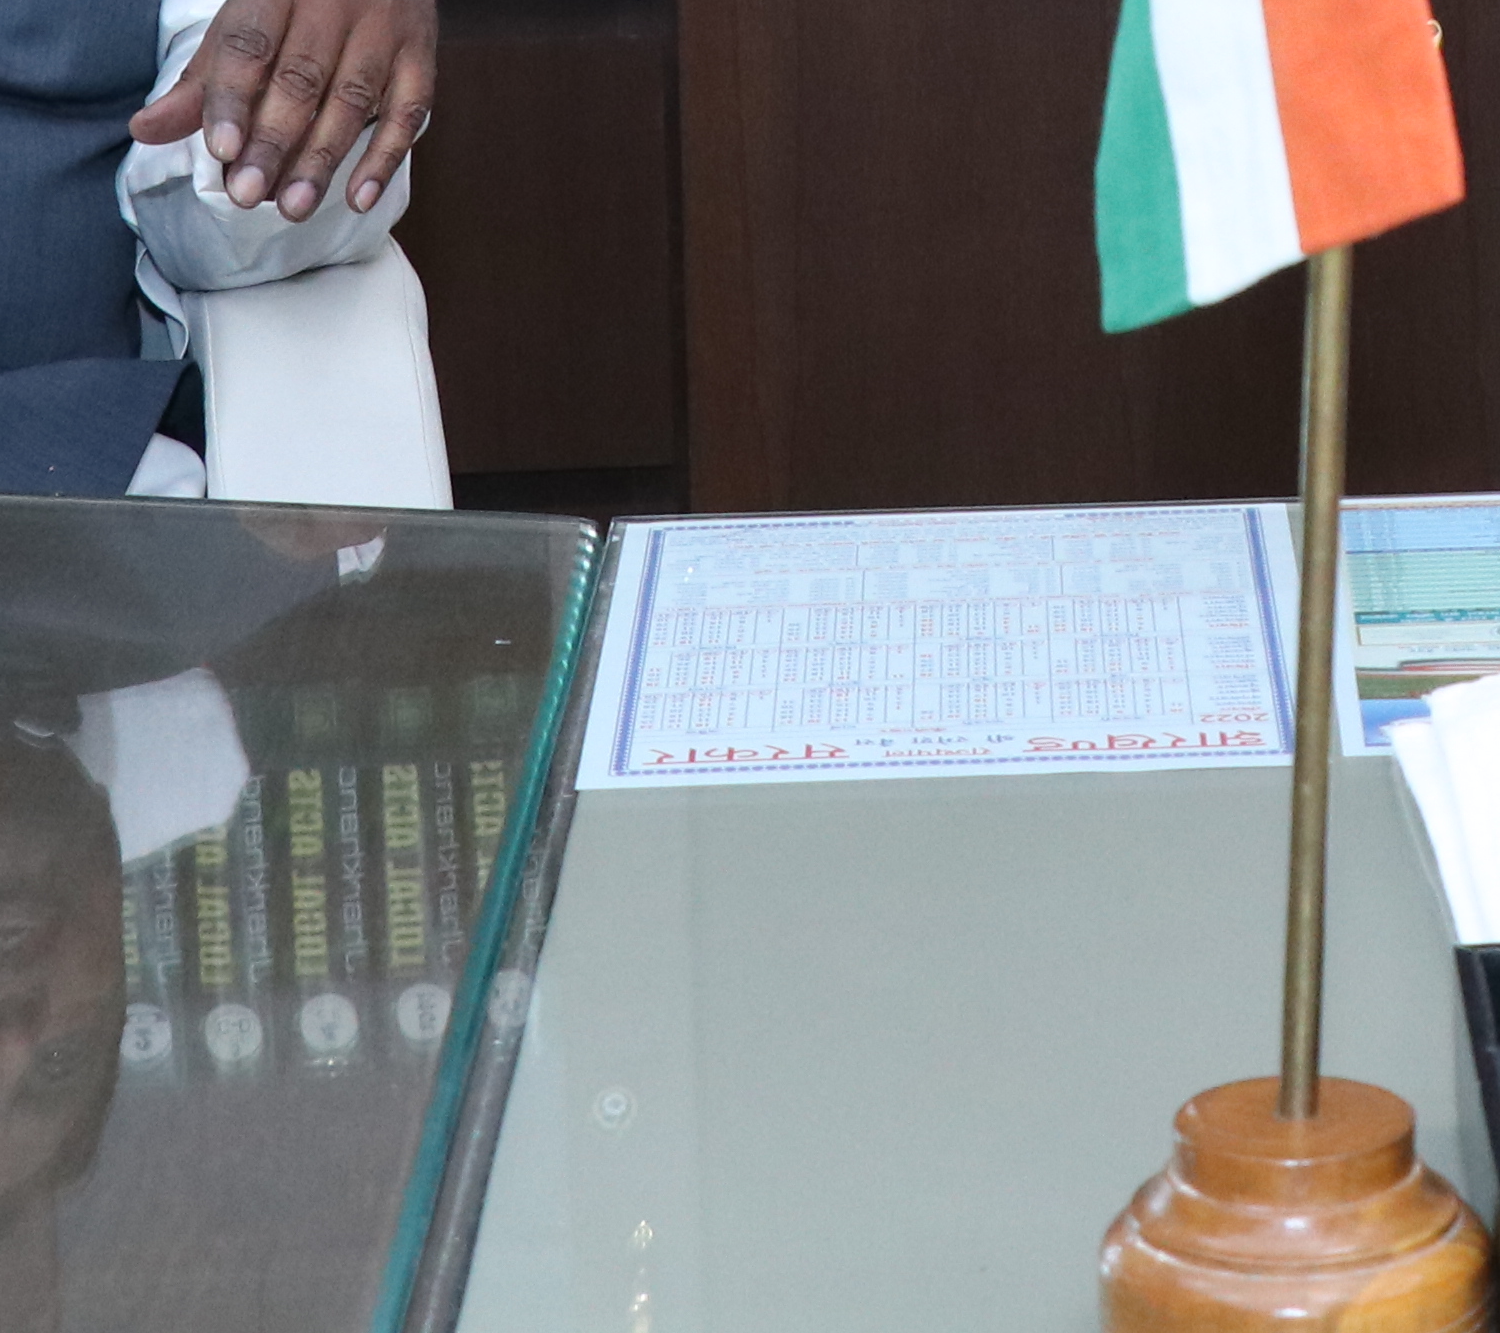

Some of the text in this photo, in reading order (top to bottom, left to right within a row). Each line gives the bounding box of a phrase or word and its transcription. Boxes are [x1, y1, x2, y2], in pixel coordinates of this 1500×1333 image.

[1200, 712, 1270, 723] 2022
[643, 731, 1266, 766] झारखण्ड सरकार
